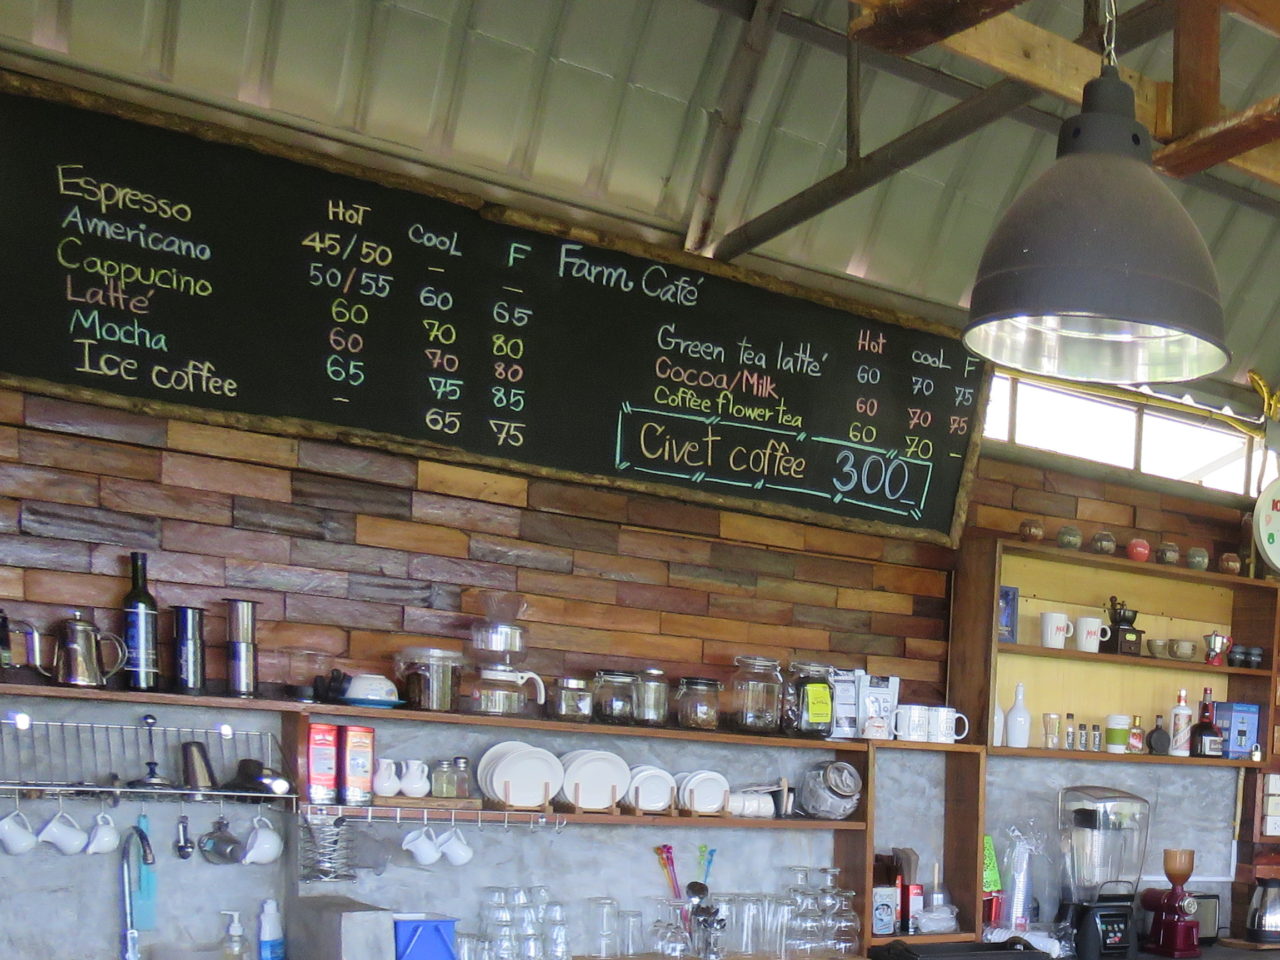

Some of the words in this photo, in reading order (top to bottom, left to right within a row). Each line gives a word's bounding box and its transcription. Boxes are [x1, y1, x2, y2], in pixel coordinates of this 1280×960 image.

[57, 163, 192, 222] Espresso
[302, 231, 392, 266] 45/50
[62, 205, 211, 261] Americano
[308, 263, 396, 298] 50/55
[419, 286, 453, 311] 60
[493, 302, 532, 327] 65
[508, 243, 531, 267] F
[558, 243, 634, 292] Farm
[57, 237, 213, 297] Cappucino
[331, 298, 369, 325] 60
[422, 319, 456, 346] 70
[492, 334, 524, 360] 80
[69, 308, 168, 352] Mocha
[326, 354, 366, 386] 65
[428, 376, 464, 401] 75
[492, 385, 526, 412] 85
[73, 339, 138, 381] Ice
[151, 360, 238, 398] coffee
[425, 407, 462, 434] 65
[488, 419, 527, 447] 75
[329, 326, 364, 354] 60
[425, 348, 459, 373] 70
[494, 362, 523, 383] 80
[657, 323, 726, 364] Green
[738, 336, 767, 371] tea
[856, 365, 881, 385] 60
[911, 376, 934, 396] 70
[954, 387, 974, 407] 75
[858, 330, 887, 355] Hot
[963, 357, 980, 378] F
[654, 386, 711, 414] Coffee
[716, 392, 775, 423] flower
[775, 398, 803, 429] tea
[848, 423, 877, 443] 60
[904, 436, 933, 459] 70
[655, 355, 780, 400] Cocoa/Milk
[855, 398, 878, 417] 60
[908, 409, 932, 428] 70
[949, 417, 968, 435] 75
[640, 421, 721, 467] Civet
[729, 438, 806, 479] coffee
[832, 450, 909, 501] 300
[1267, 533, 1275, 545] 8
